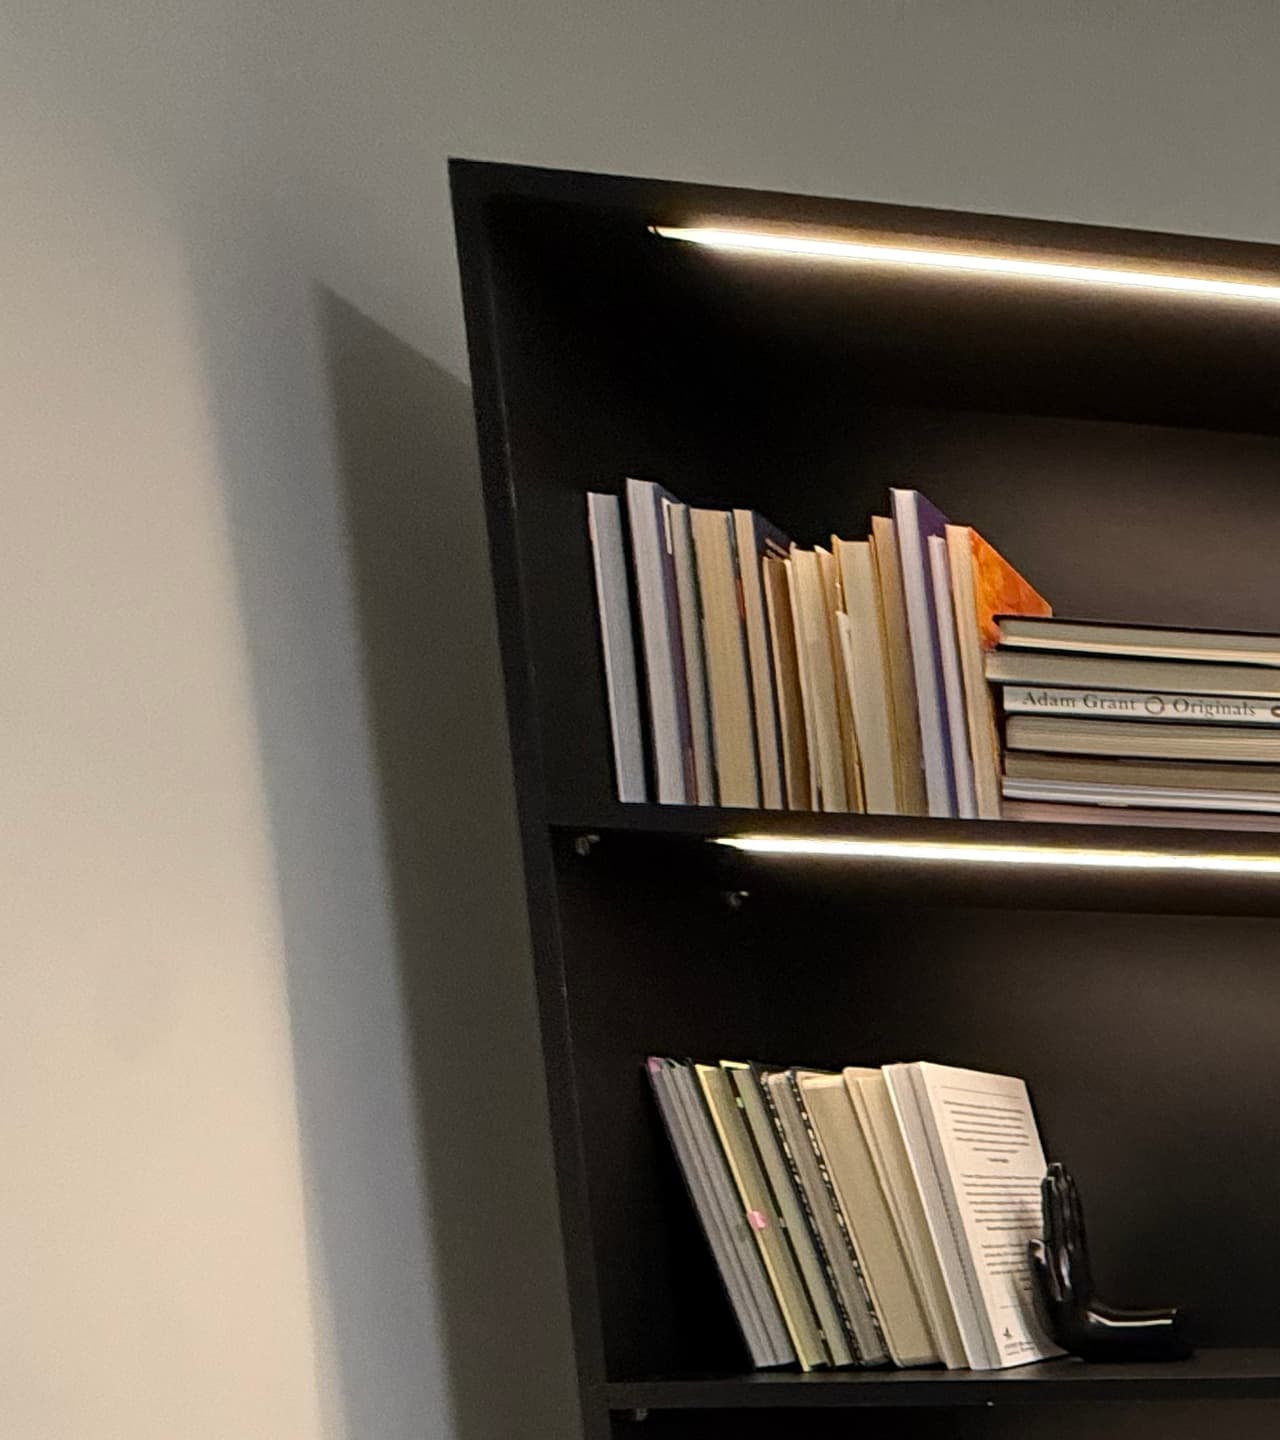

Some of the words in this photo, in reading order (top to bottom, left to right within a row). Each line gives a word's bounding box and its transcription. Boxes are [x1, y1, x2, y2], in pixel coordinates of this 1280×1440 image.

[1022, 691, 1076, 708] Adam
[1082, 693, 1137, 711] Grant
[1172, 696, 1256, 717] Originals
